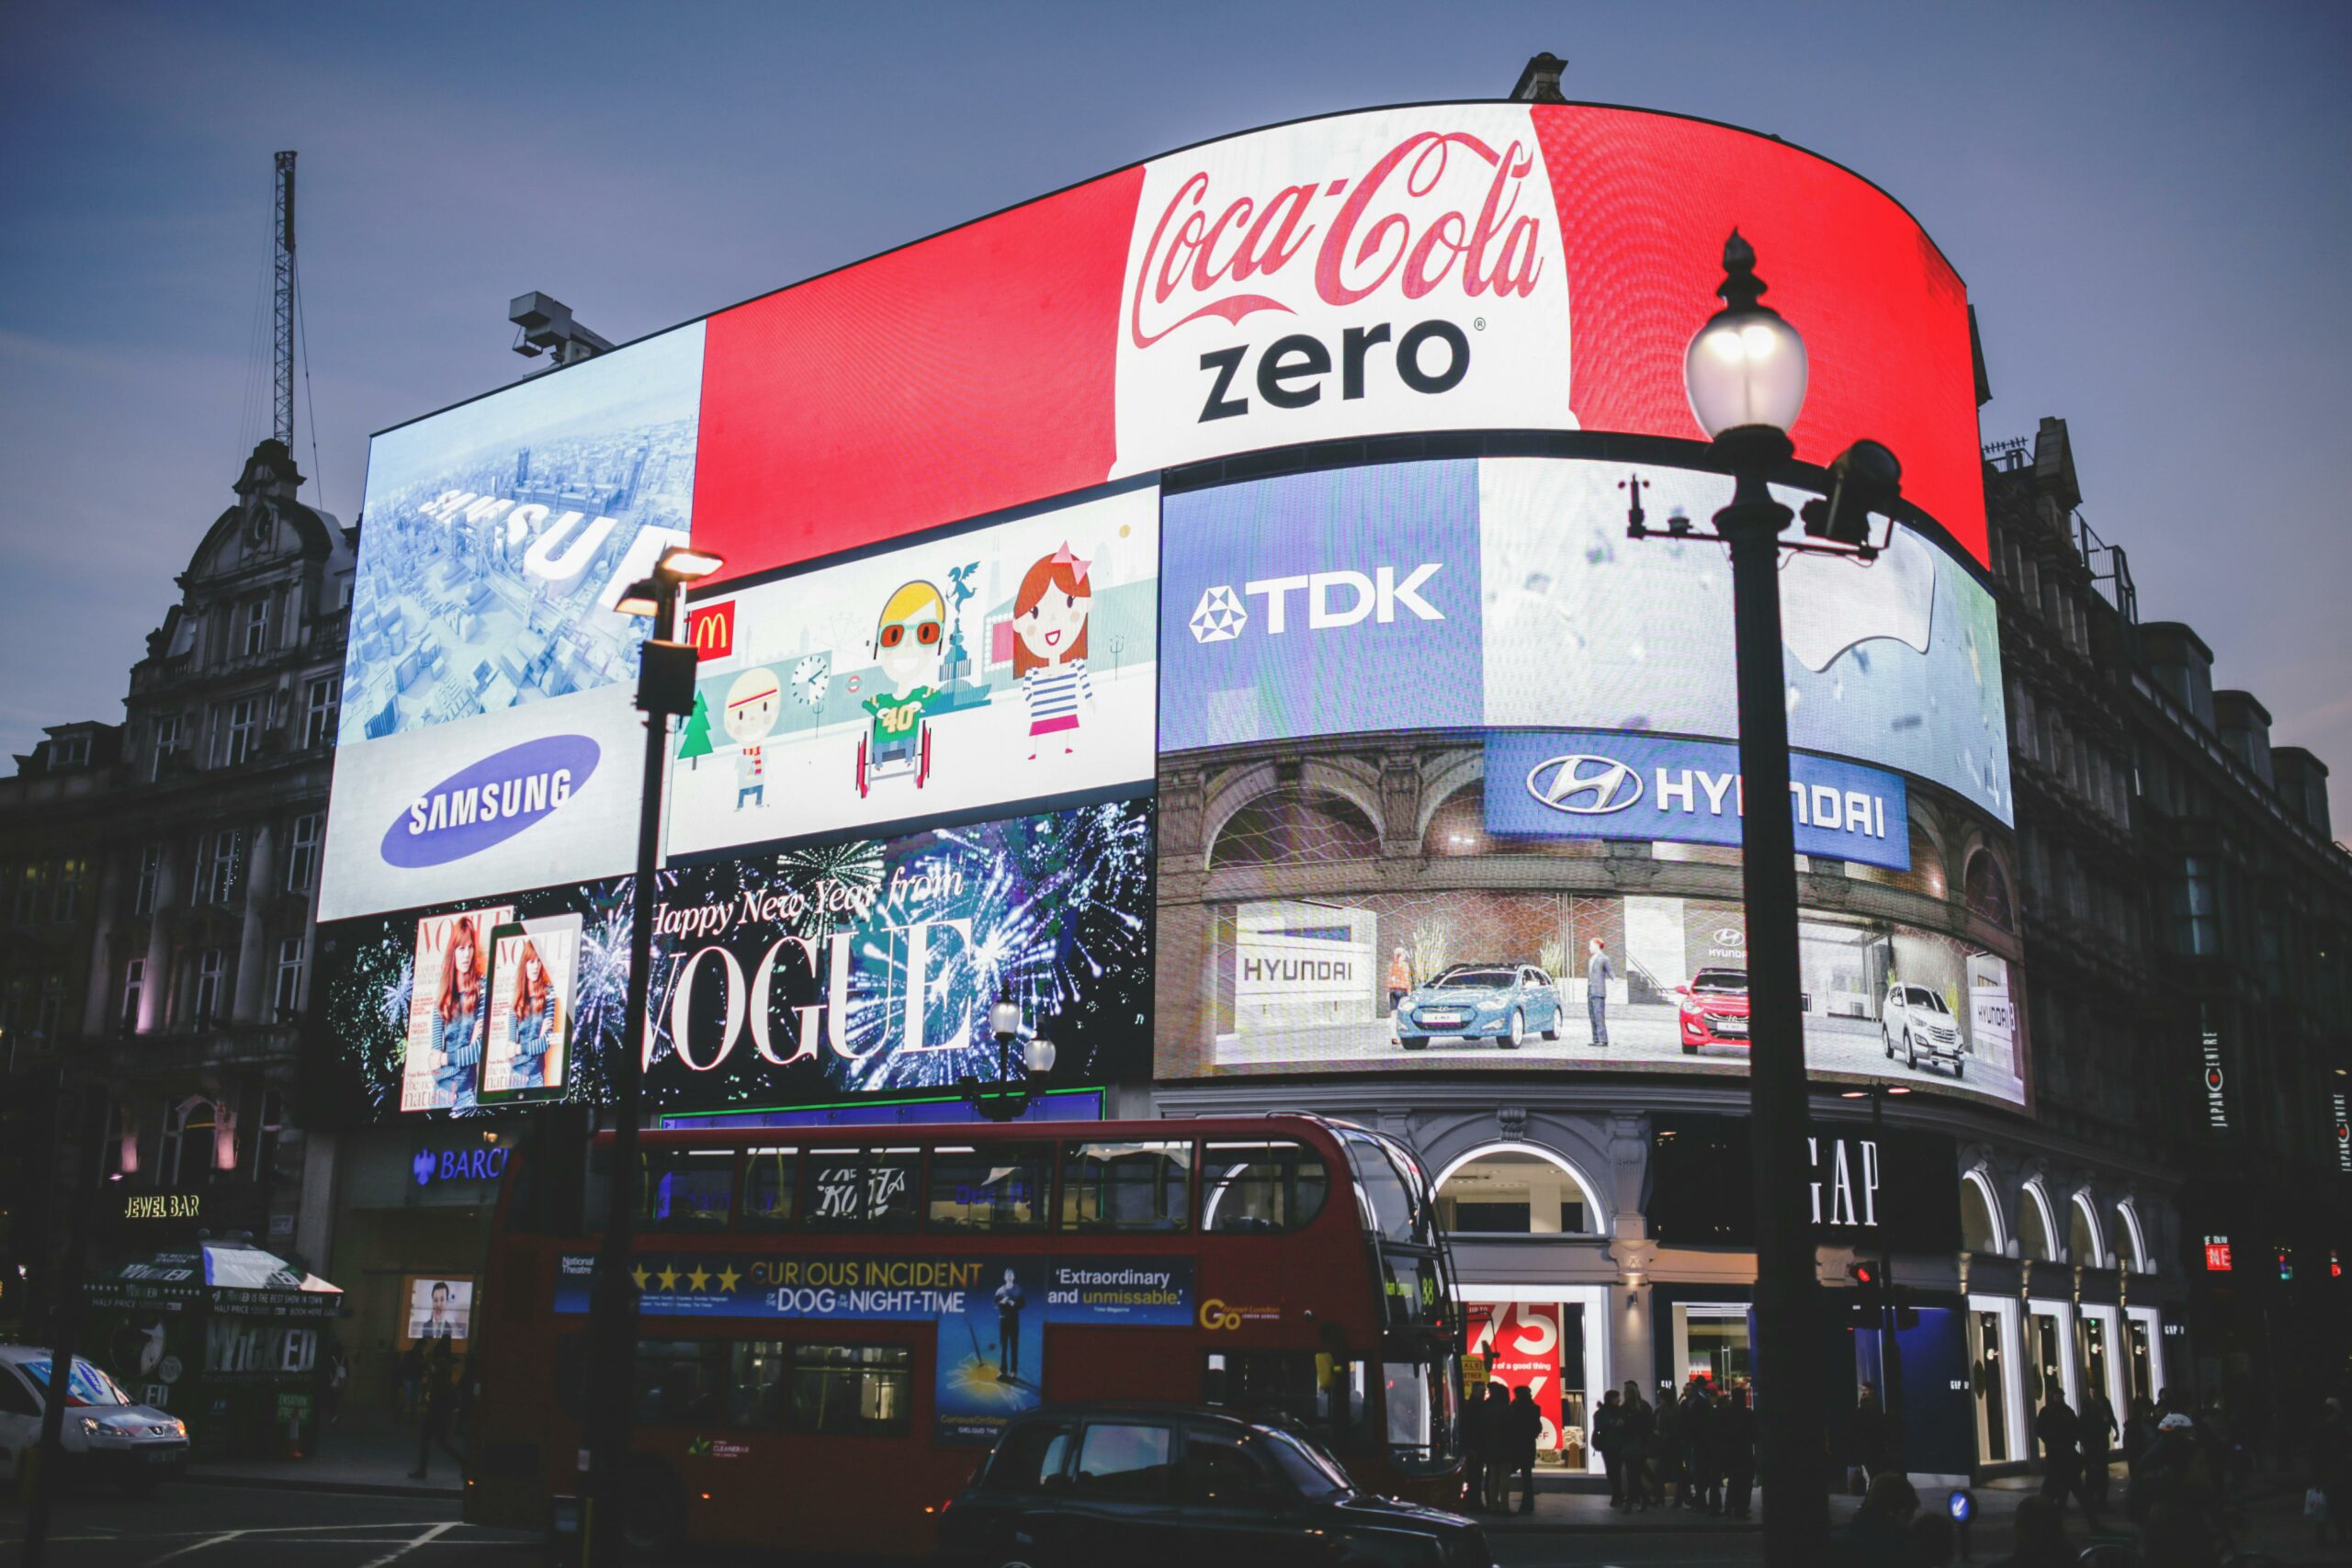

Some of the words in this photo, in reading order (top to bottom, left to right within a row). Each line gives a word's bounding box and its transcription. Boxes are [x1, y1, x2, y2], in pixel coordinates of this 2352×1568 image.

[1132, 130, 1544, 349] Coca-Cola
[1197, 319, 1470, 423] zero
[1245, 563, 1446, 635] TDK
[409, 768, 571, 835] SAMSUNG
[1656, 768, 1885, 839] HYNDAI
[737, 888, 805, 926] New
[815, 876, 882, 915] Year
[877, 865, 966, 908] from
[1709, 949, 1747, 959] HYUNDA
[1244, 958, 1352, 981] HYUNDAI
[125, 1195, 166, 1218] JEWEL
[169, 1194, 199, 1217] BAR
[562, 1257, 595, 1267] National
[562, 1266, 593, 1274] Theatre
[753, 1261, 859, 1286] CURIOUS
[865, 1261, 981, 1287] INCIDENT
[777, 1288, 836, 1313] DOG
[849, 1290, 966, 1313] NIGHT-TIME
[1047, 1289, 1079, 1303] and
[1422, 1278, 1433, 1305] 88
[1200, 1299, 1240, 1331] Go
[1471, 1303, 1557, 1356] 75
[1497, 1361, 1507, 1371] of
[1512, 1362, 1532, 1372] good
[1532, 1360, 1551, 1372] thing
